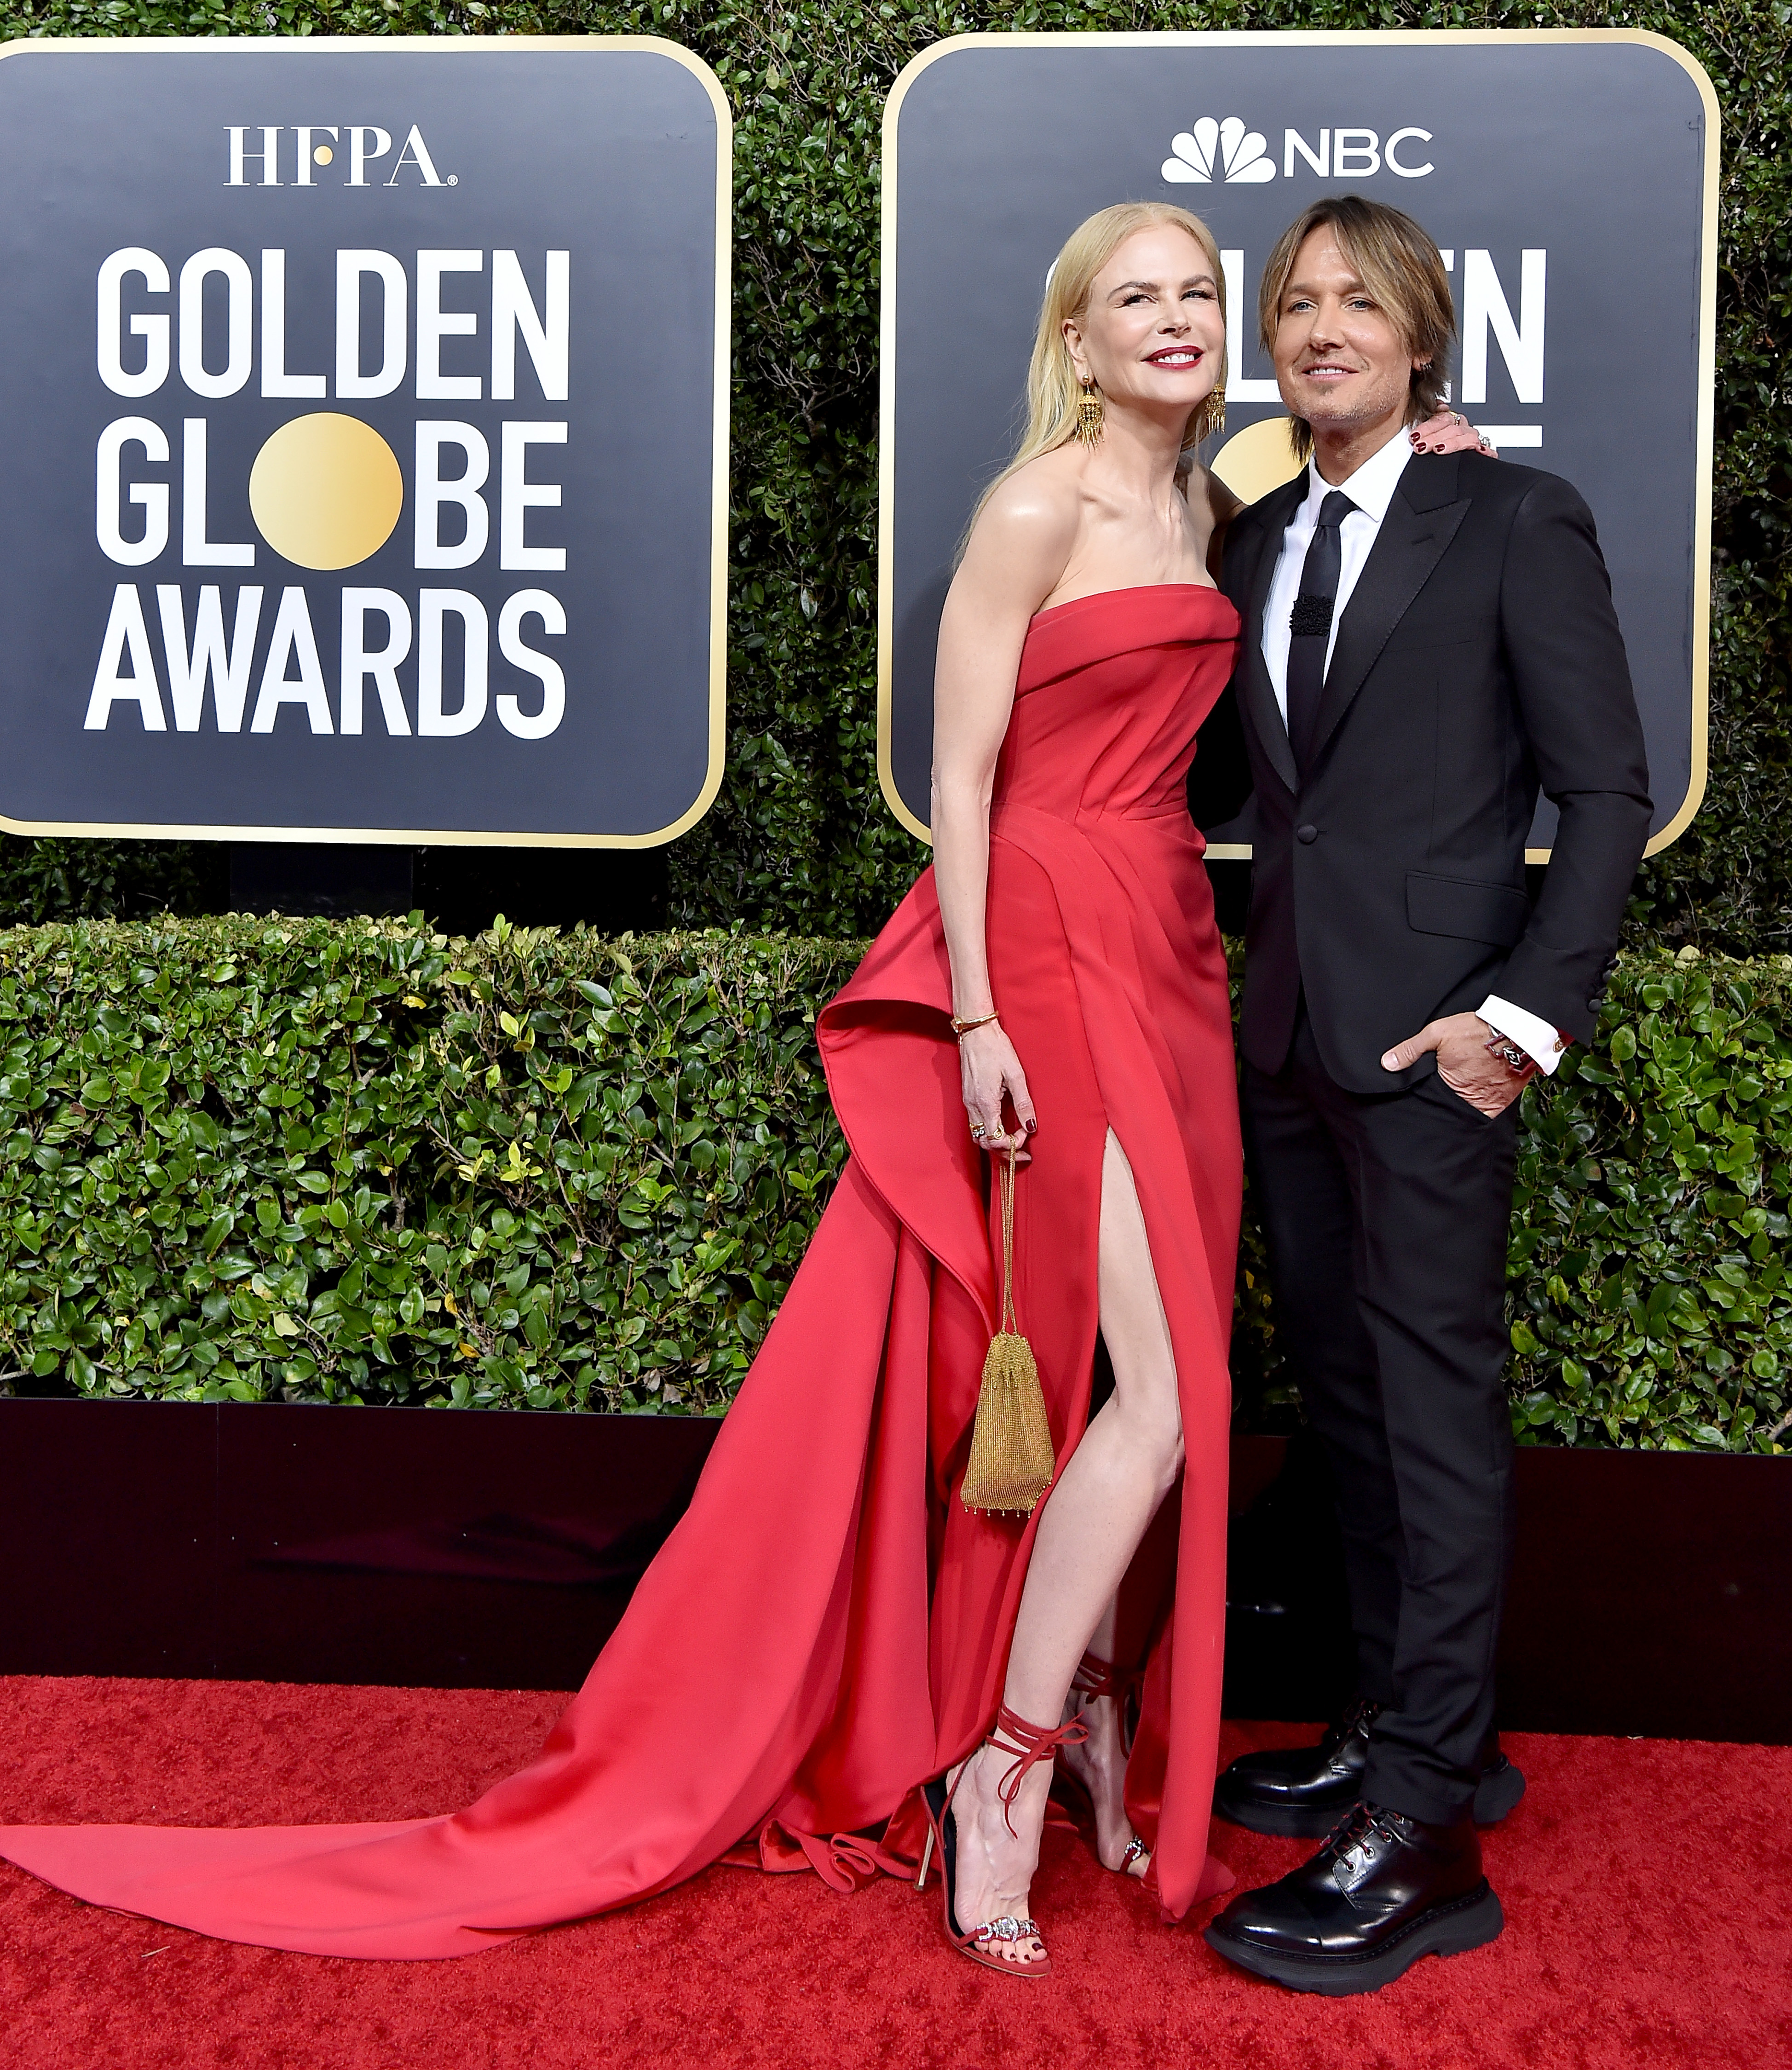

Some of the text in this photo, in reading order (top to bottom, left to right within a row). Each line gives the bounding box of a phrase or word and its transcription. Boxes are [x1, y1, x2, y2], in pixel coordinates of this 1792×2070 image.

[1284, 127, 1435, 178] NBC
[97, 247, 570, 400] GOLDEN
[83, 584, 567, 740] AWARDS
